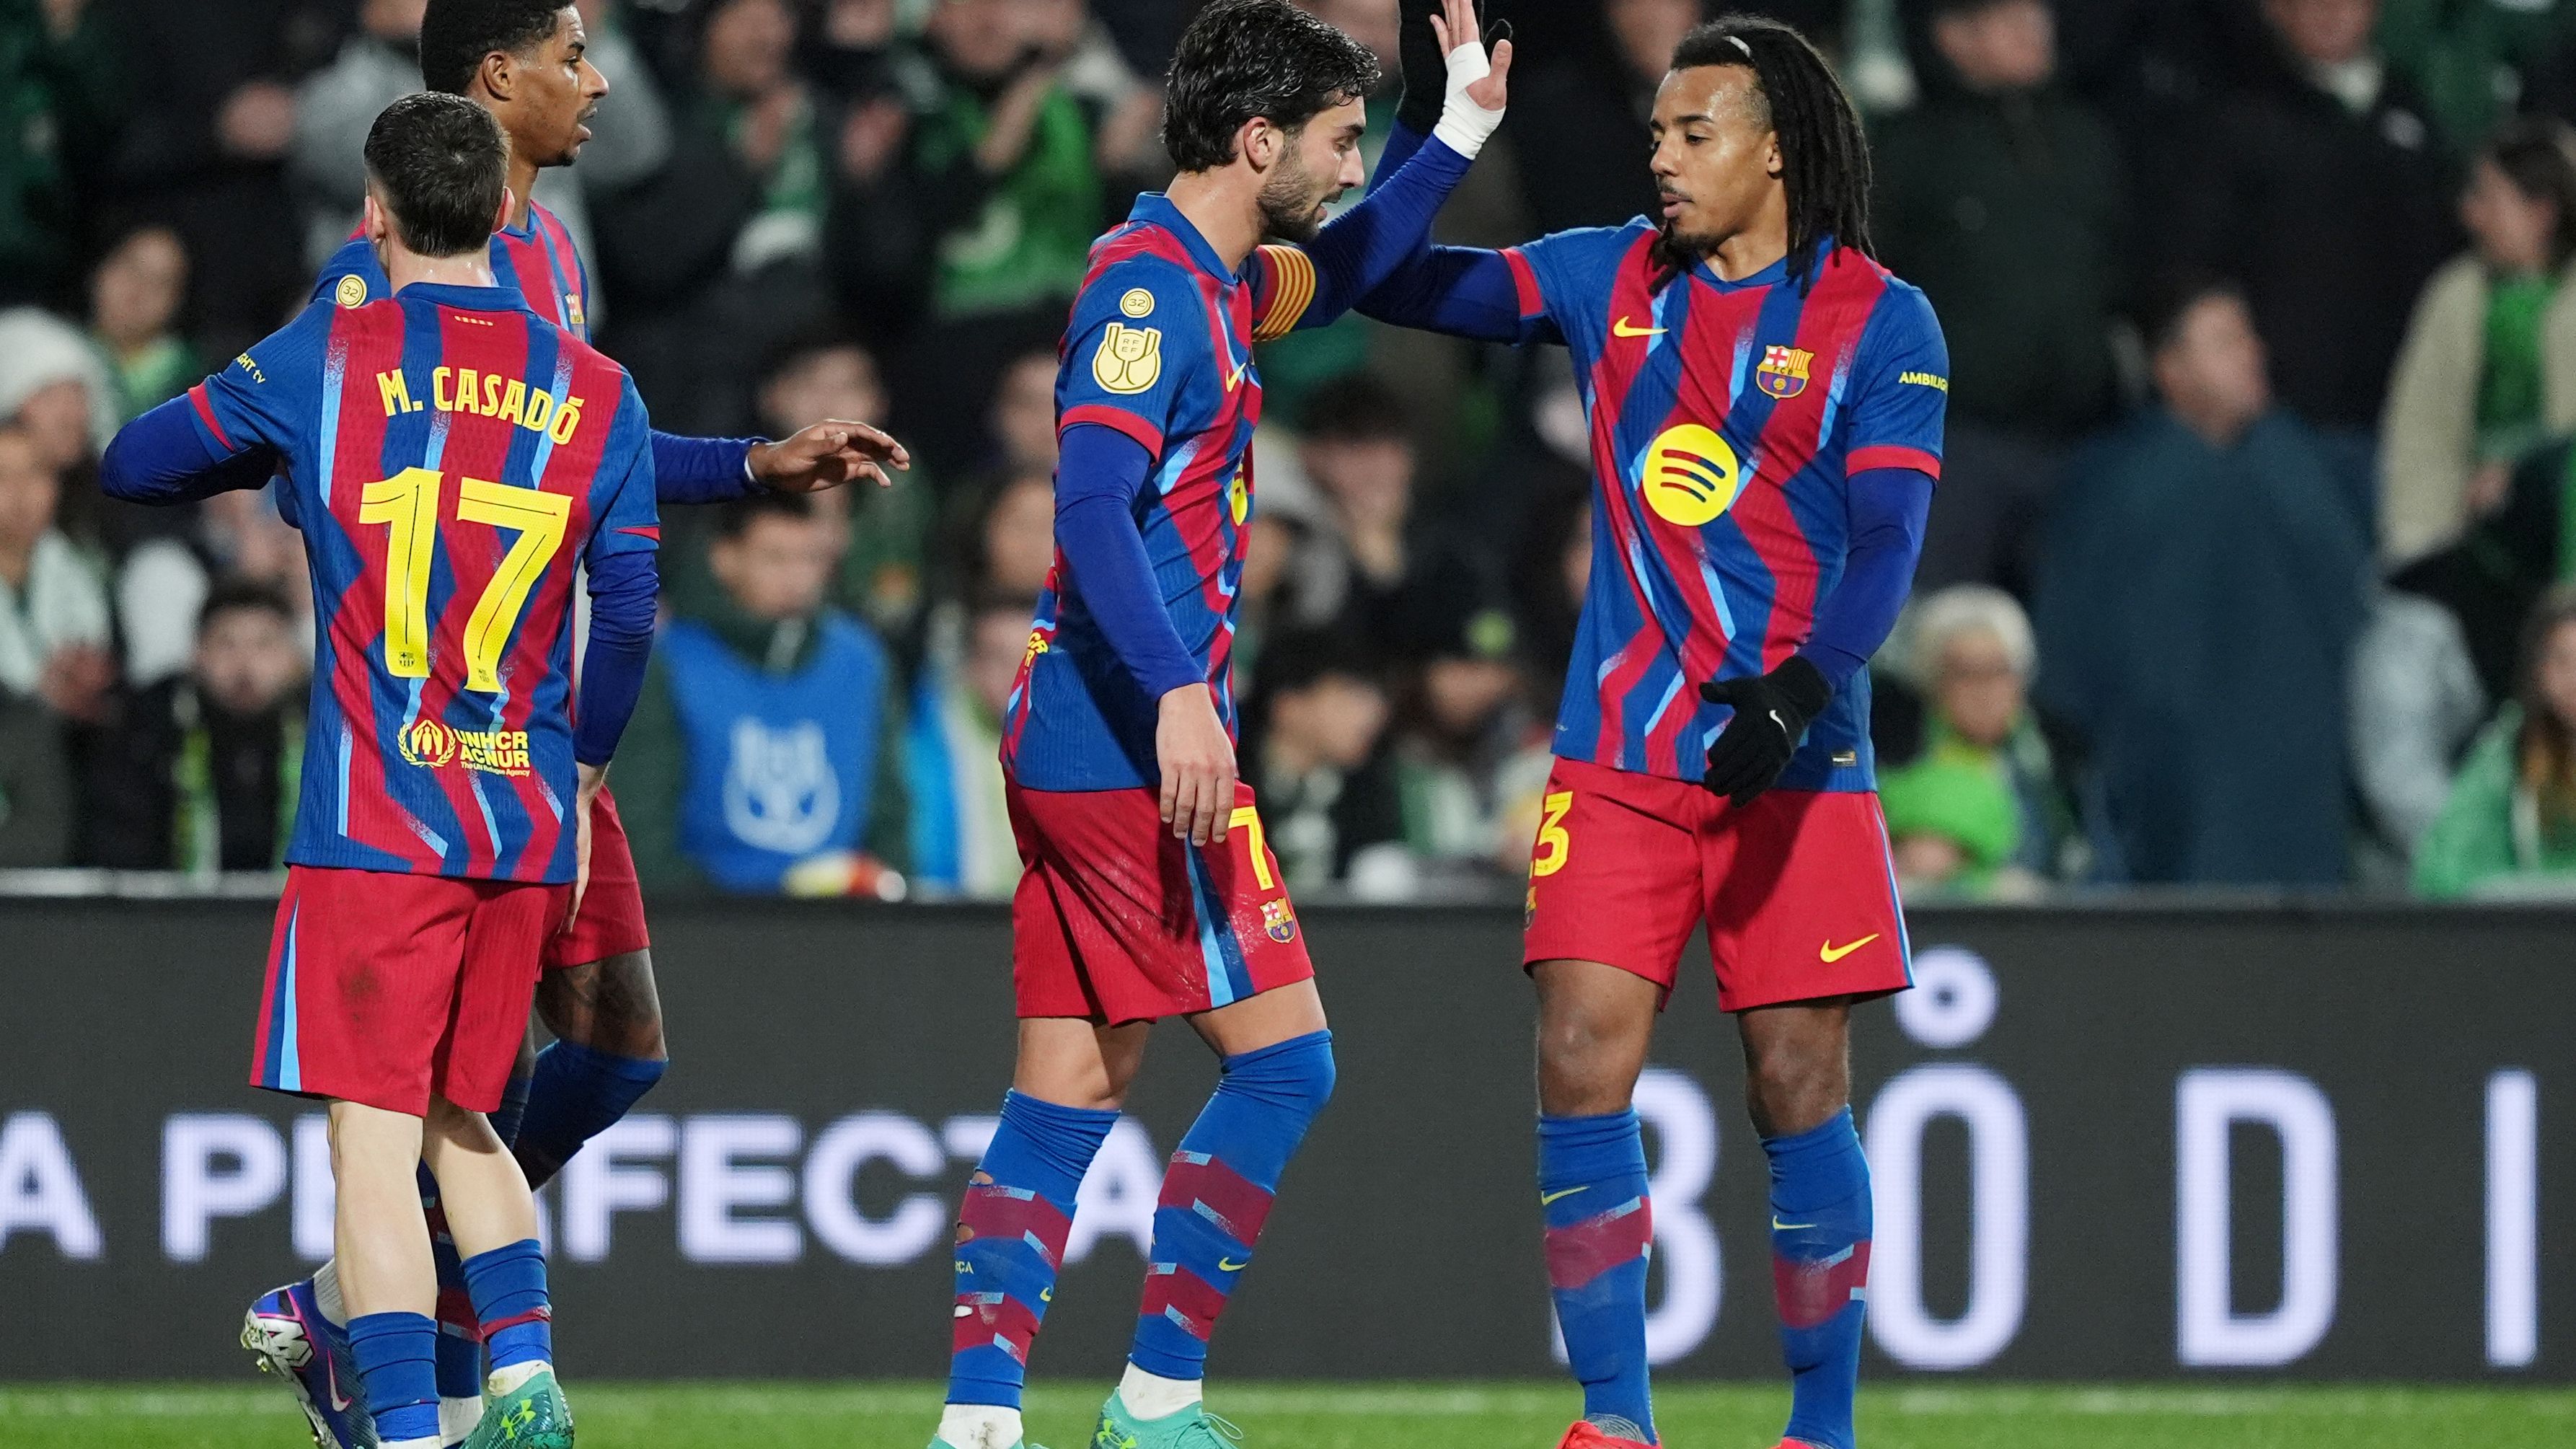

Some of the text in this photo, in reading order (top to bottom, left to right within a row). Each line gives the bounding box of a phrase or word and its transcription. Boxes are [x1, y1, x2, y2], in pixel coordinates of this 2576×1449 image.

[343, 285, 358, 298] 32
[1129, 299, 1145, 307] 32
[376, 366, 584, 445] M. CASADÓ
[358, 466, 574, 693] 17
[453, 728, 529, 750] UNHCR
[459, 744, 530, 768] ACNUR
[1228, 806, 1275, 891] 7
[1529, 791, 1573, 879] 3
[0, 1111, 103, 1261] A
